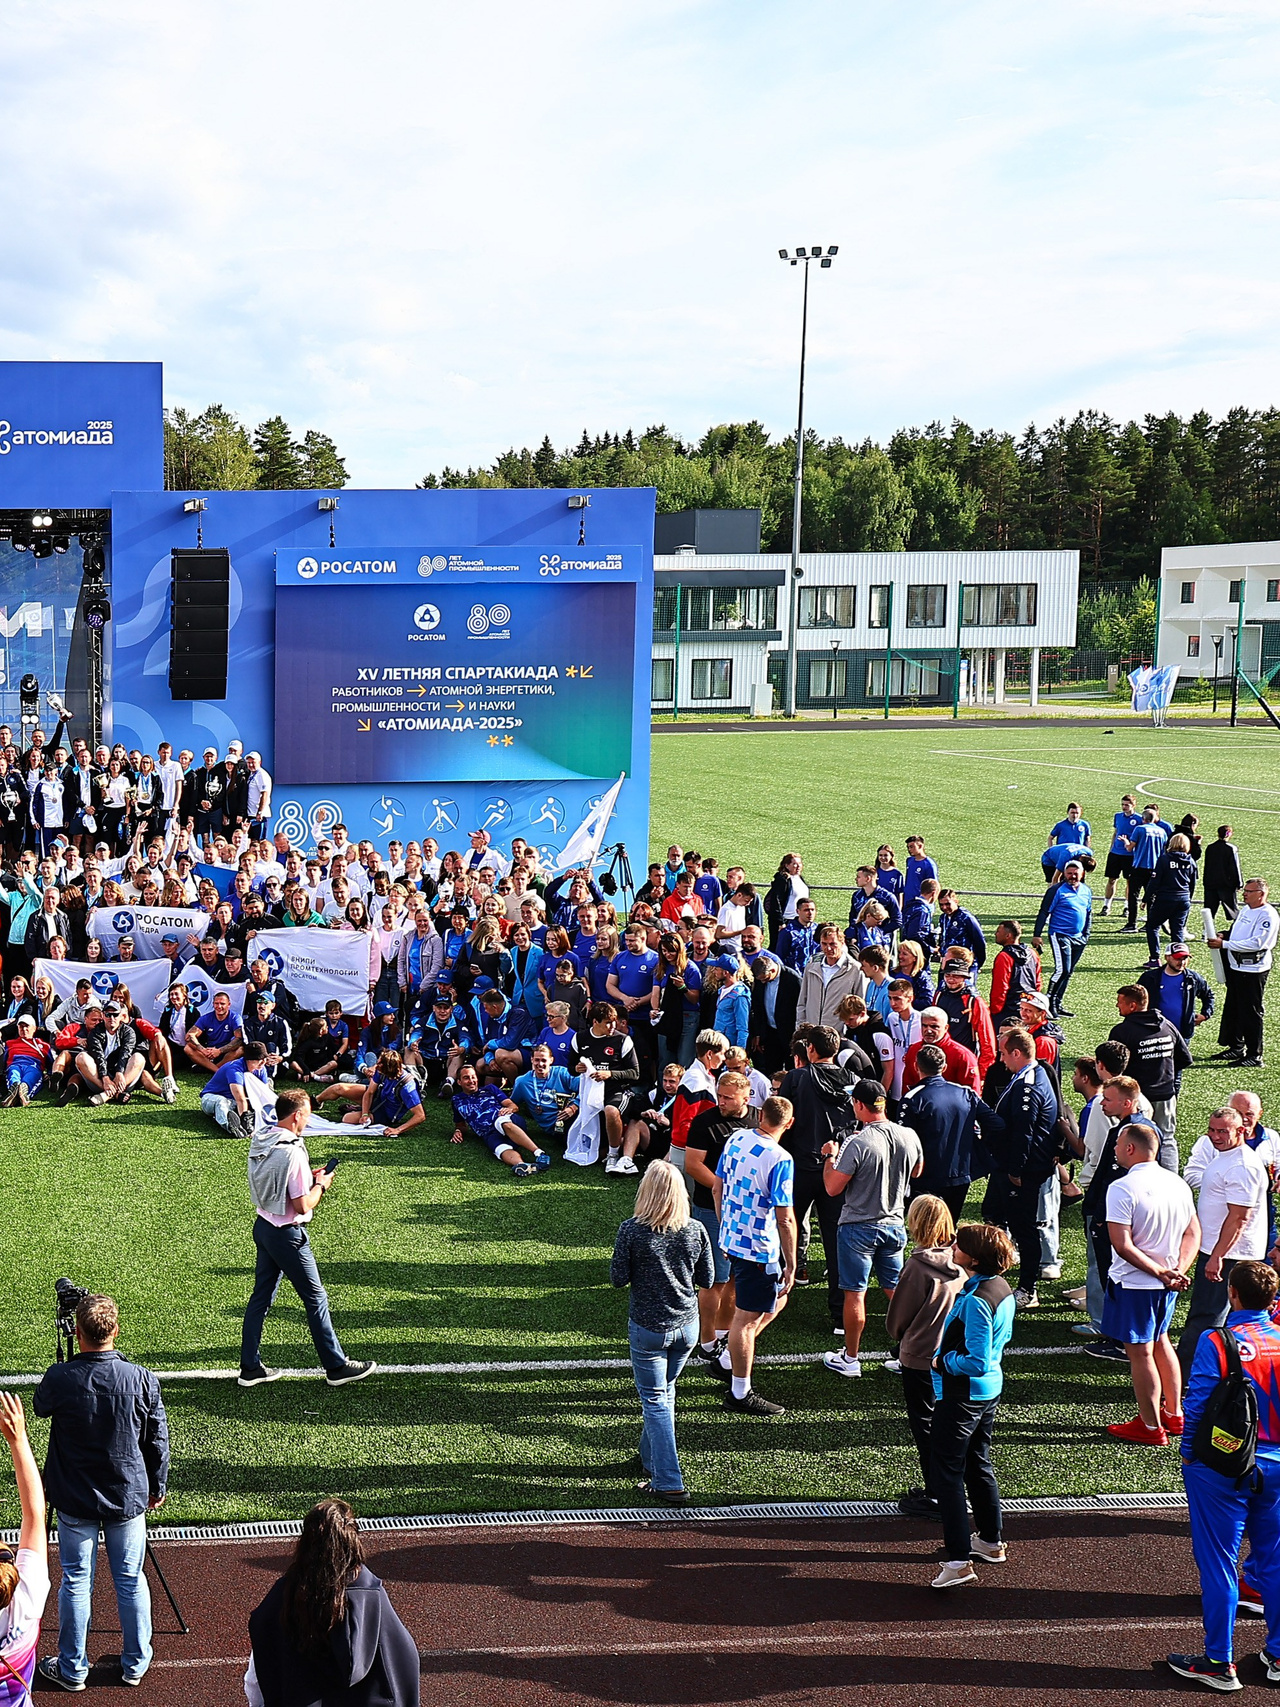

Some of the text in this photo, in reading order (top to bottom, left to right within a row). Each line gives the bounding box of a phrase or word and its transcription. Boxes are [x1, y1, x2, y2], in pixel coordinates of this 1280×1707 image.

[87, 421, 113, 430] 2025
[12, 430, 114, 445] атомиада
[321, 560, 396, 574] РОСАТОМ
[561, 560, 622, 570] атомиада
[357, 666, 559, 681] XV ЛЕТНЯЯ СПАРТАКИАДА
[332, 684, 556, 697] РАБОТНИКОВ АТОМНОЙ ЭНЕРГЕТИКИ,
[332, 701, 515, 713] ПРОМЫШЛЕННОСТИ И НАУКИ
[377, 716, 523, 732] «АТОМИАДА-2025»
[136, 914, 194, 928] РОСАТОМ
[290, 964, 359, 976] ПРОМТЕХНОЛОГИИ
